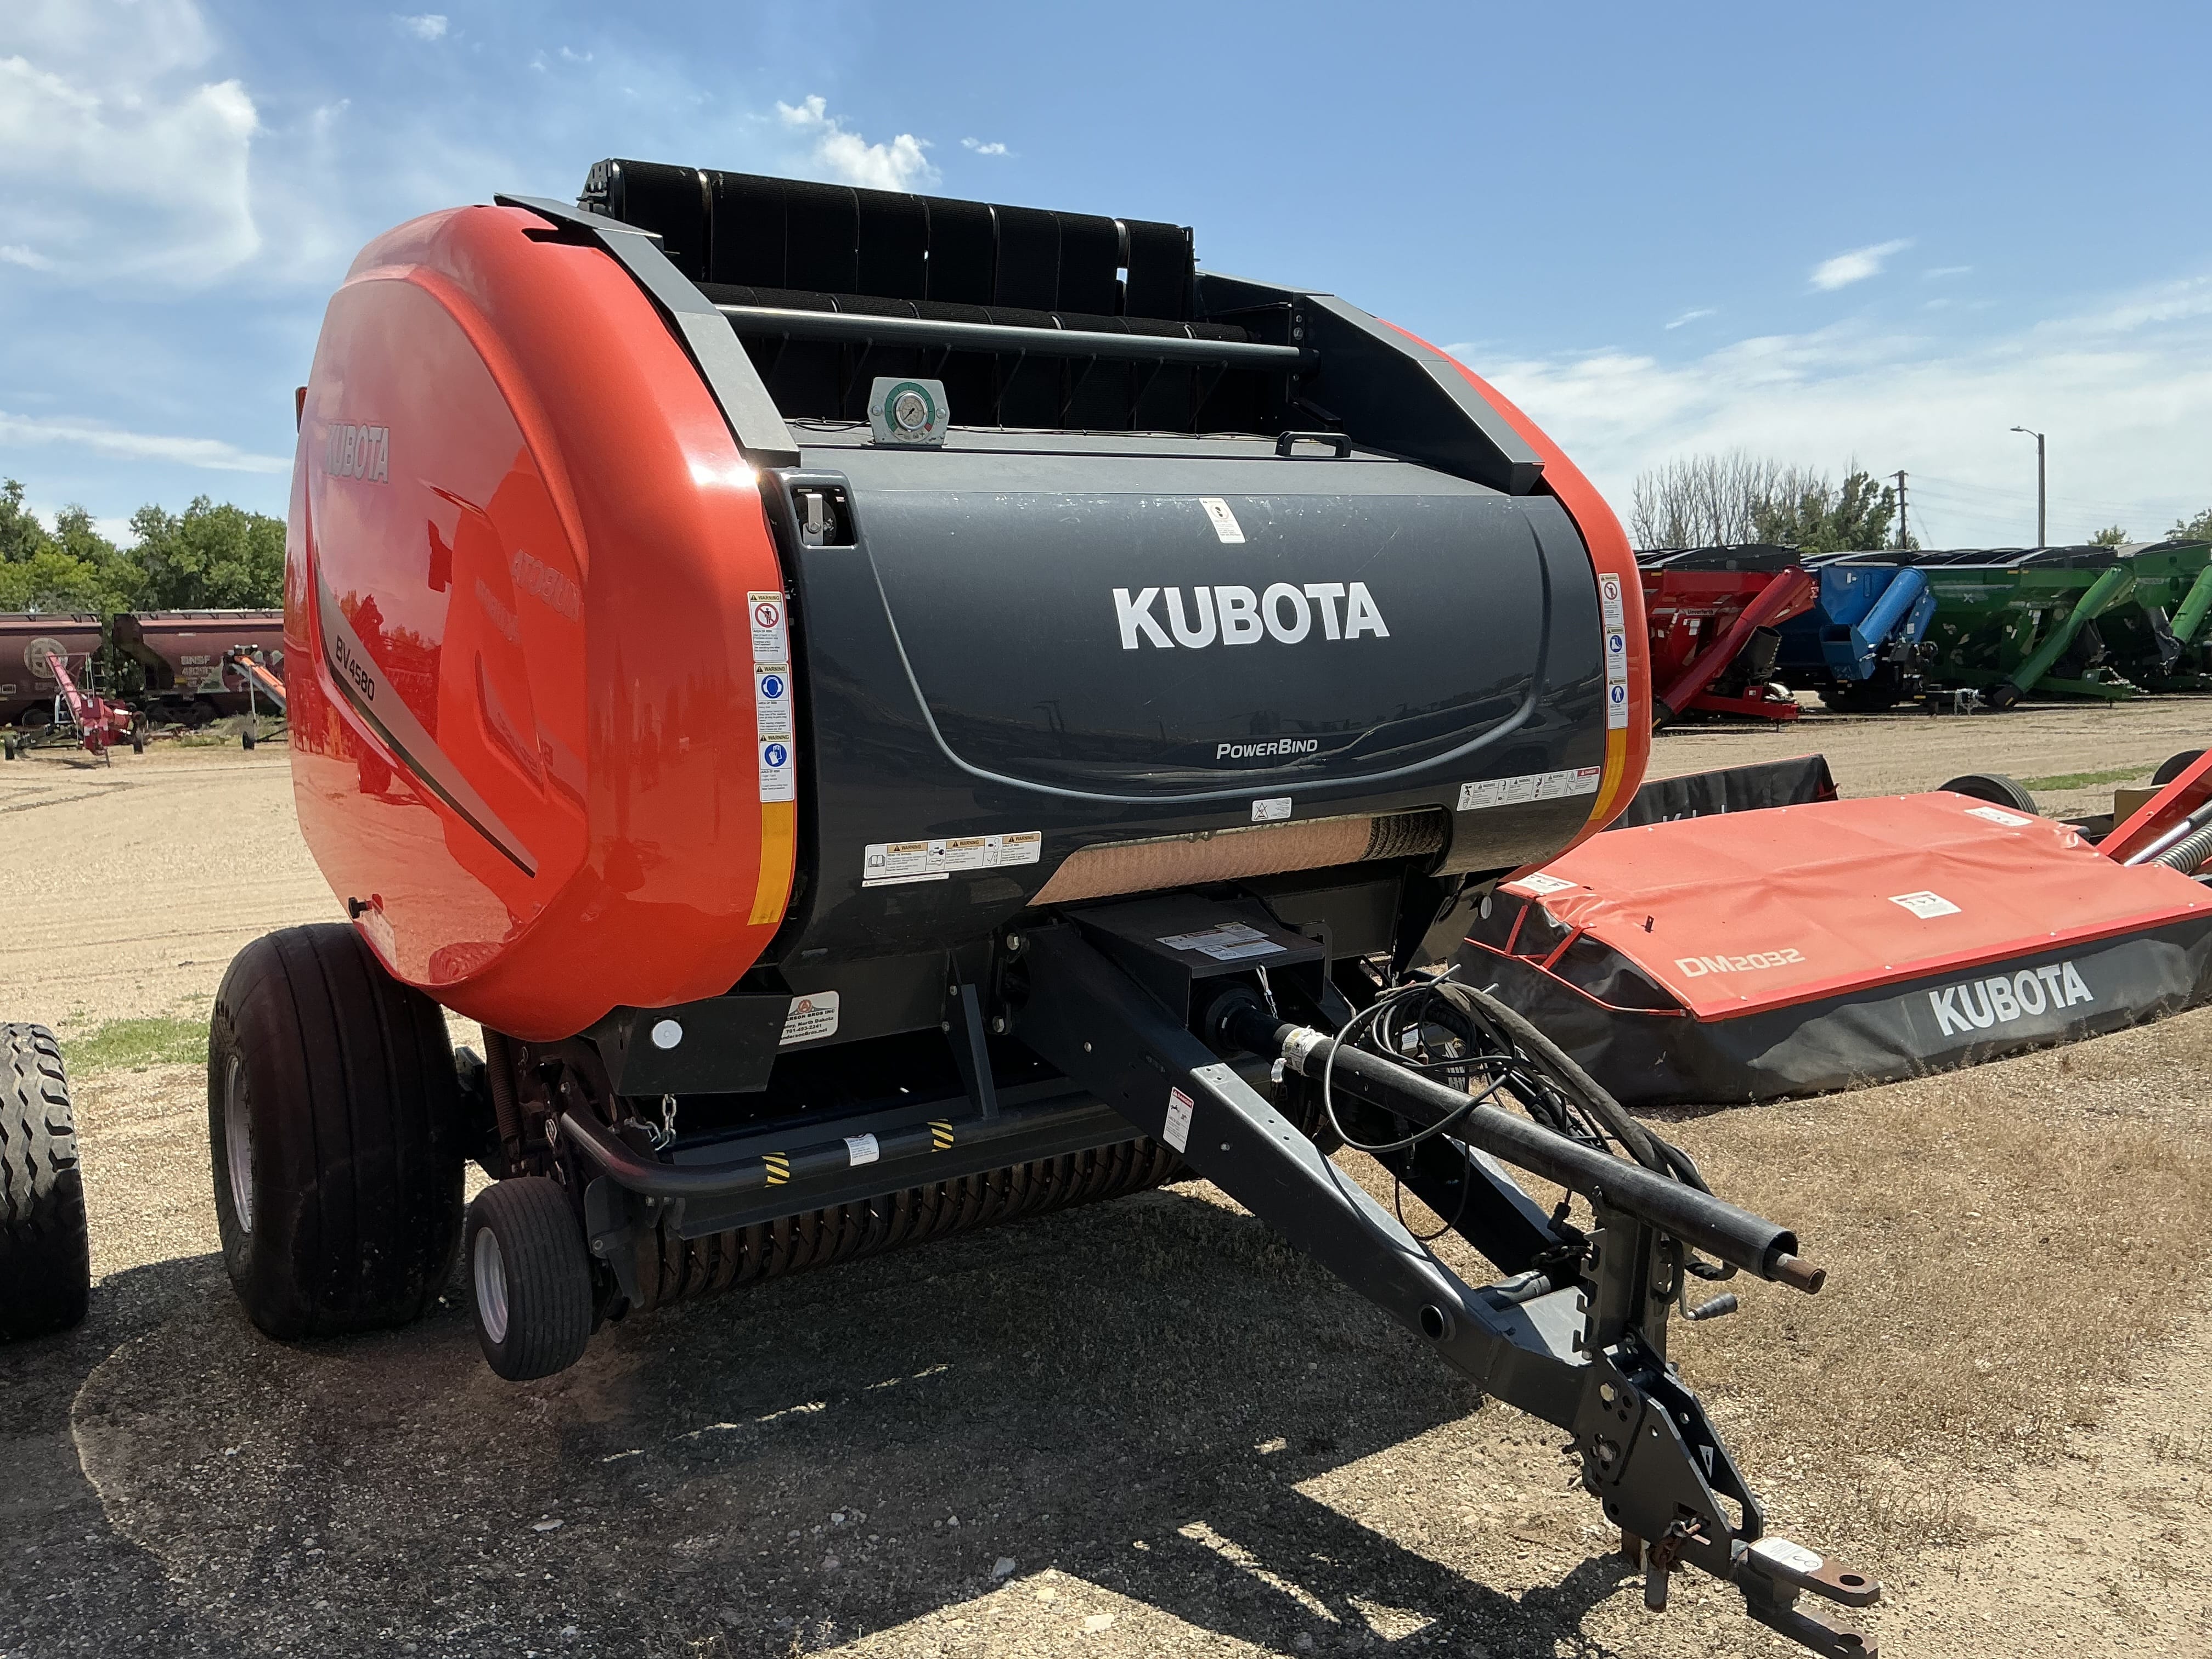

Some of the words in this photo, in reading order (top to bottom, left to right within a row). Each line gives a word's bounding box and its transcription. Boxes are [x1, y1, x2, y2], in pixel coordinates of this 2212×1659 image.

[1112, 582, 1390, 649] KUBOTA
[336, 635, 375, 701] BV4580
[1674, 948, 1805, 978] DM2032
[1928, 961, 2095, 1036] KUBOTA
